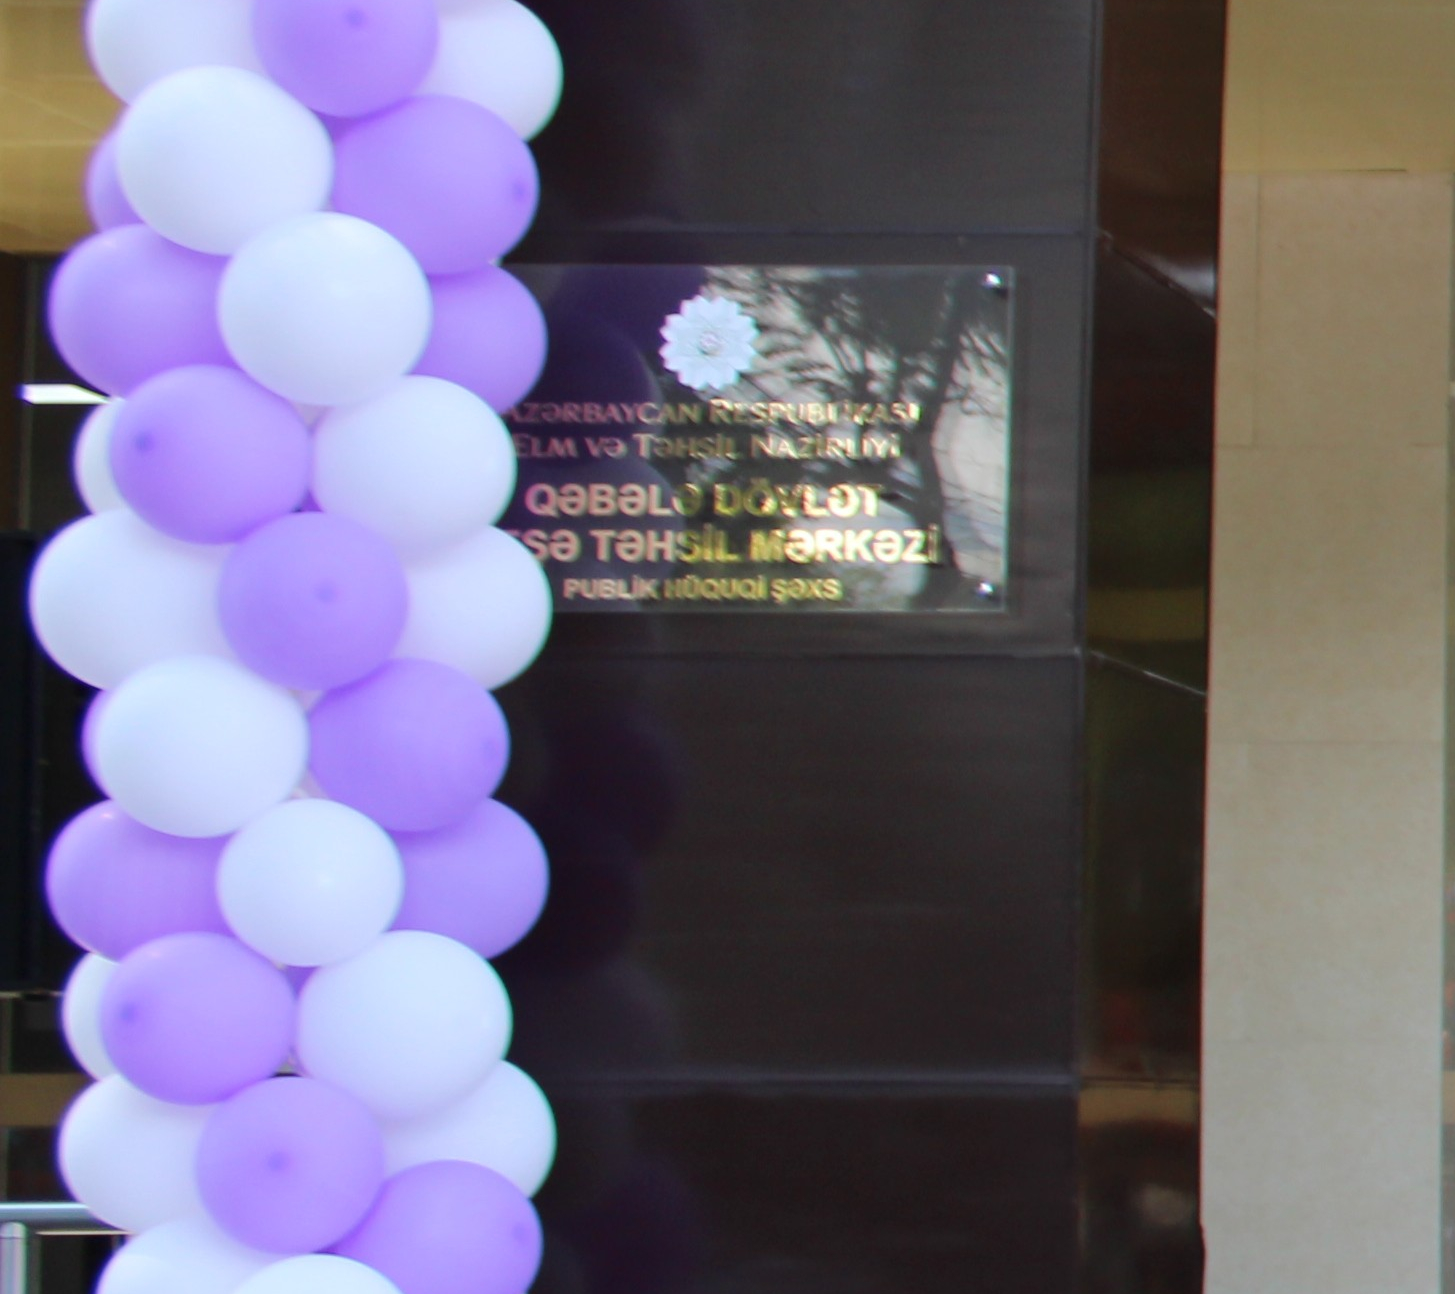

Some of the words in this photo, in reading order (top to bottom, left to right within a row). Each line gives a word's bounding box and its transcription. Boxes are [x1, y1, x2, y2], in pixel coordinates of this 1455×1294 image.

[525, 482, 704, 518] QƏBƏLƏ
[713, 477, 882, 518] DÖVLƏT
[589, 523, 742, 563] TƏHSİL
[750, 523, 941, 564] MƏRKƏZİ
